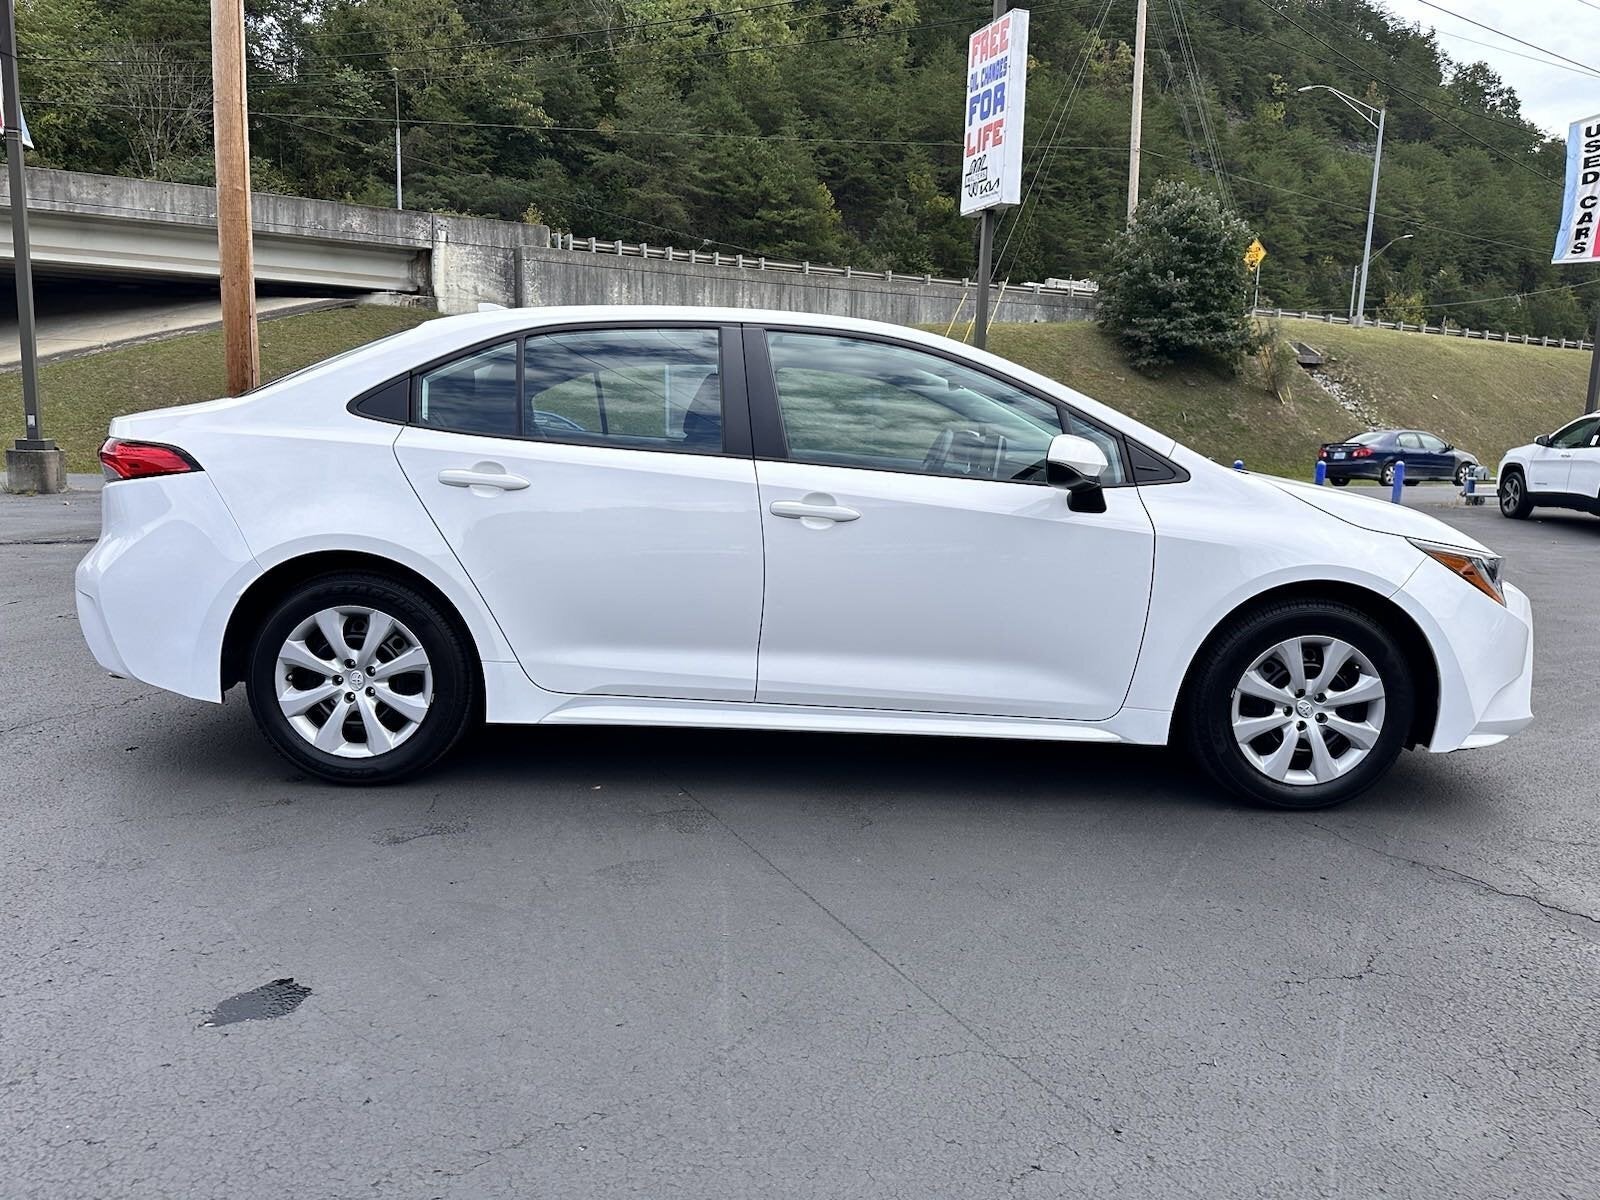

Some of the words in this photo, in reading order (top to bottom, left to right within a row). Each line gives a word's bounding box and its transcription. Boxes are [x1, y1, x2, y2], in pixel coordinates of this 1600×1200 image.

[971, 17, 1010, 68] FREE
[970, 71, 979, 93] OIL
[981, 55, 1008, 88] CHANGES
[968, 82, 1006, 127] FOR
[966, 118, 1004, 158] LIFE
[1581, 124, 1600, 185] USED
[1571, 195, 1598, 255] CARS
